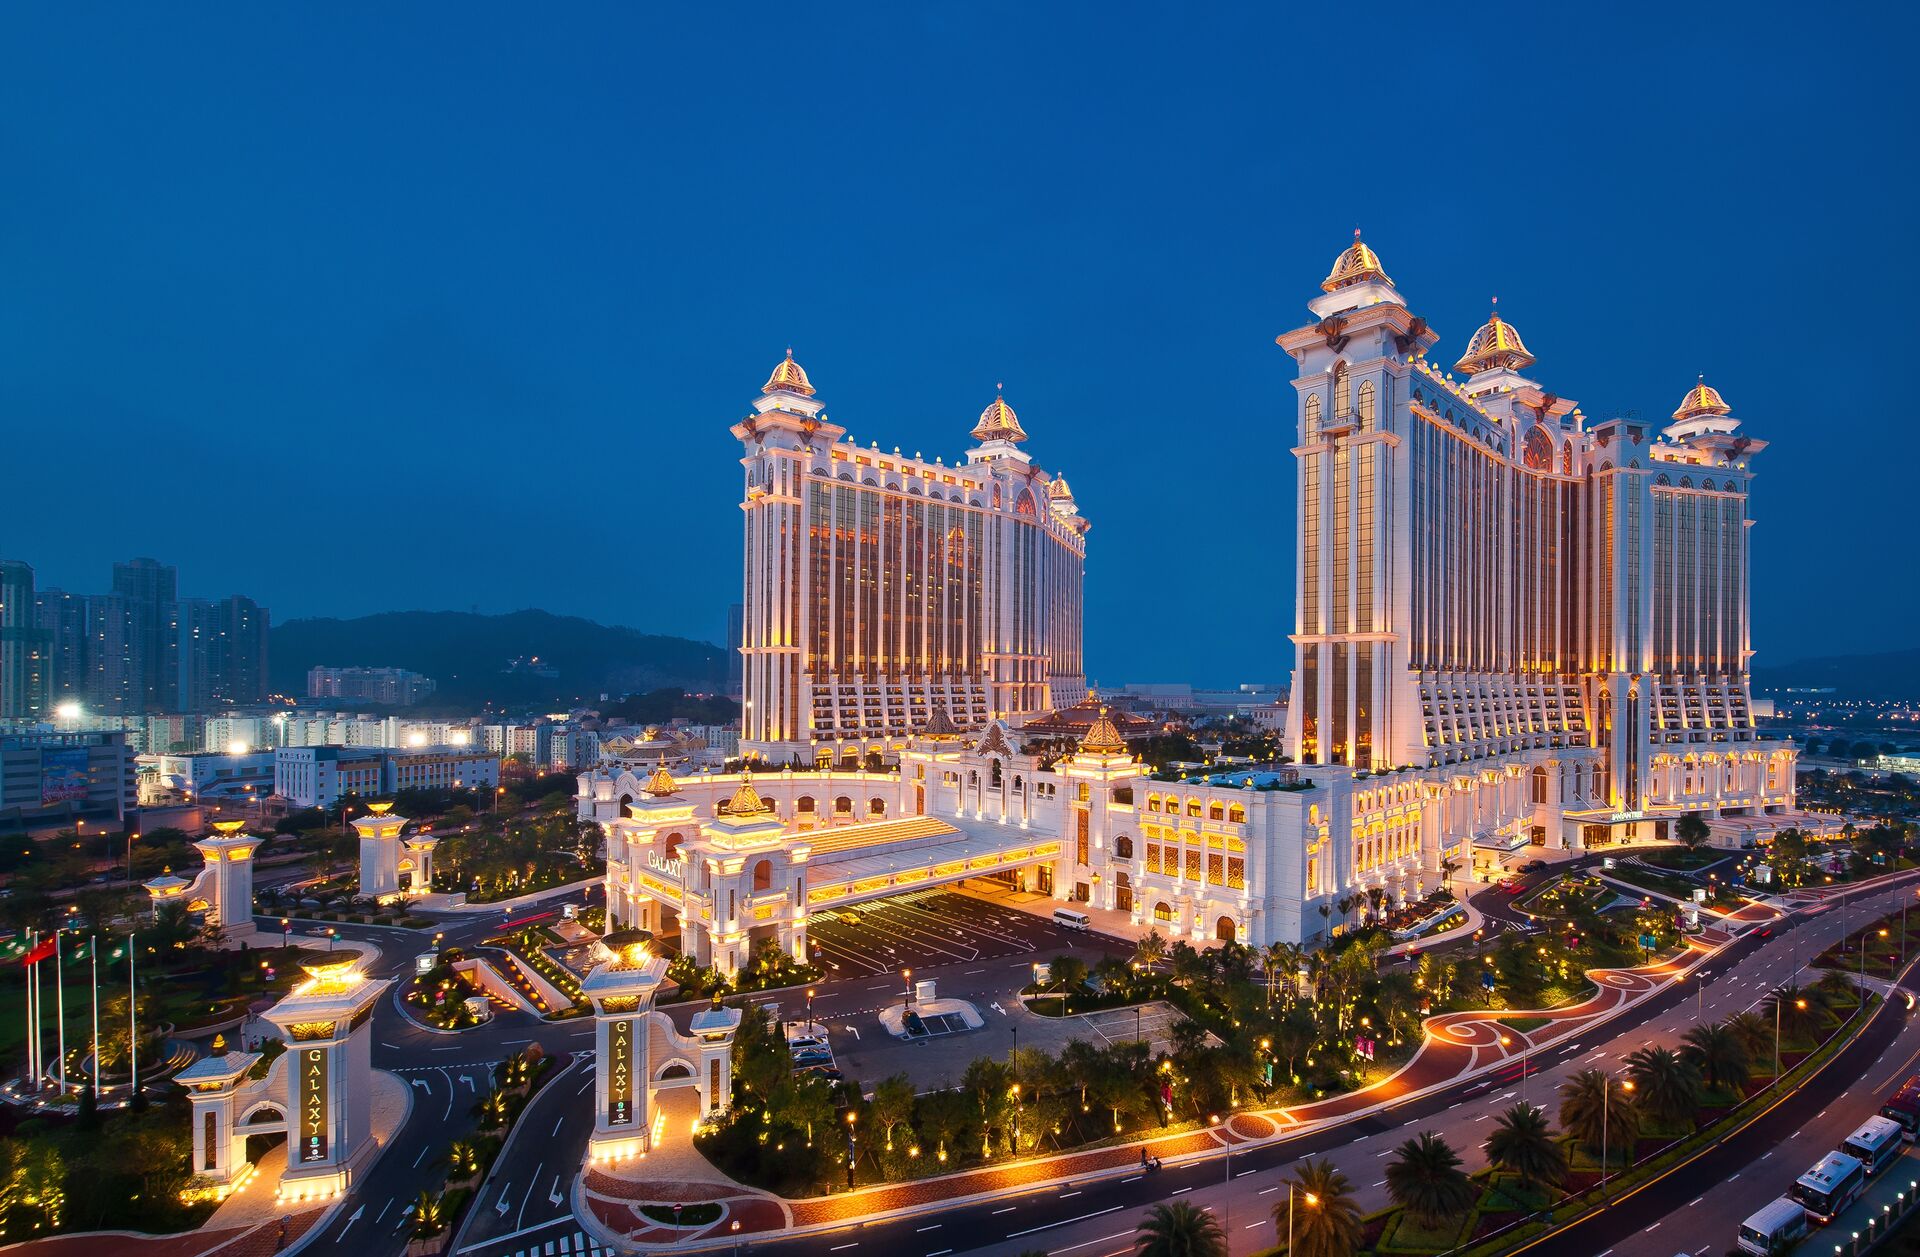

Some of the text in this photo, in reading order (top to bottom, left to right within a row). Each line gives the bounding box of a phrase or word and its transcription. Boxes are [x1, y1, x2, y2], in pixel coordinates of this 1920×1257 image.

[648, 850, 682, 878] GALAXY
[308, 1049, 321, 1135] GALAXY
[615, 1021, 627, 1100] GALAXY
